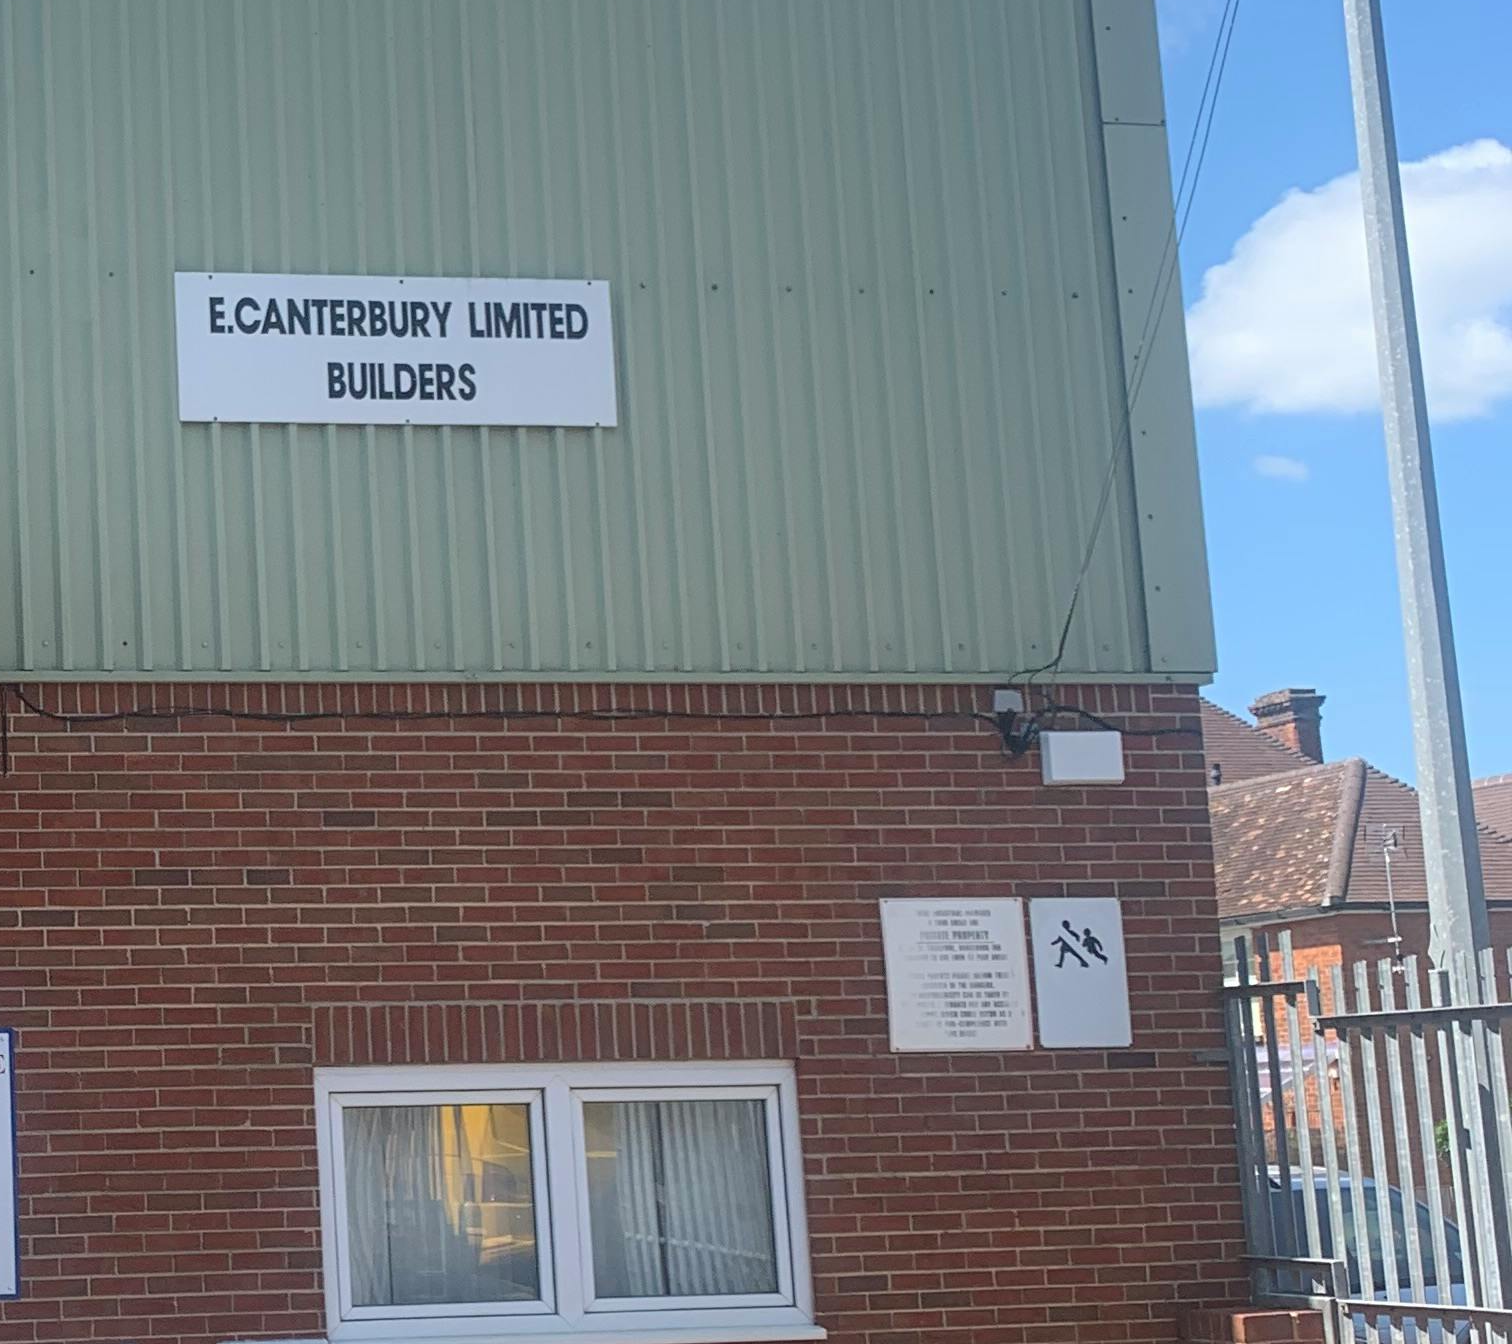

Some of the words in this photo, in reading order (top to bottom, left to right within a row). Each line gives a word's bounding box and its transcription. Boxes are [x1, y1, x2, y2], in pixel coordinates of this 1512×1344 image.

[209, 296, 452, 339] E.CANTERBURY
[469, 301, 589, 340] LIMITED
[327, 361, 477, 401] BUILDERS
